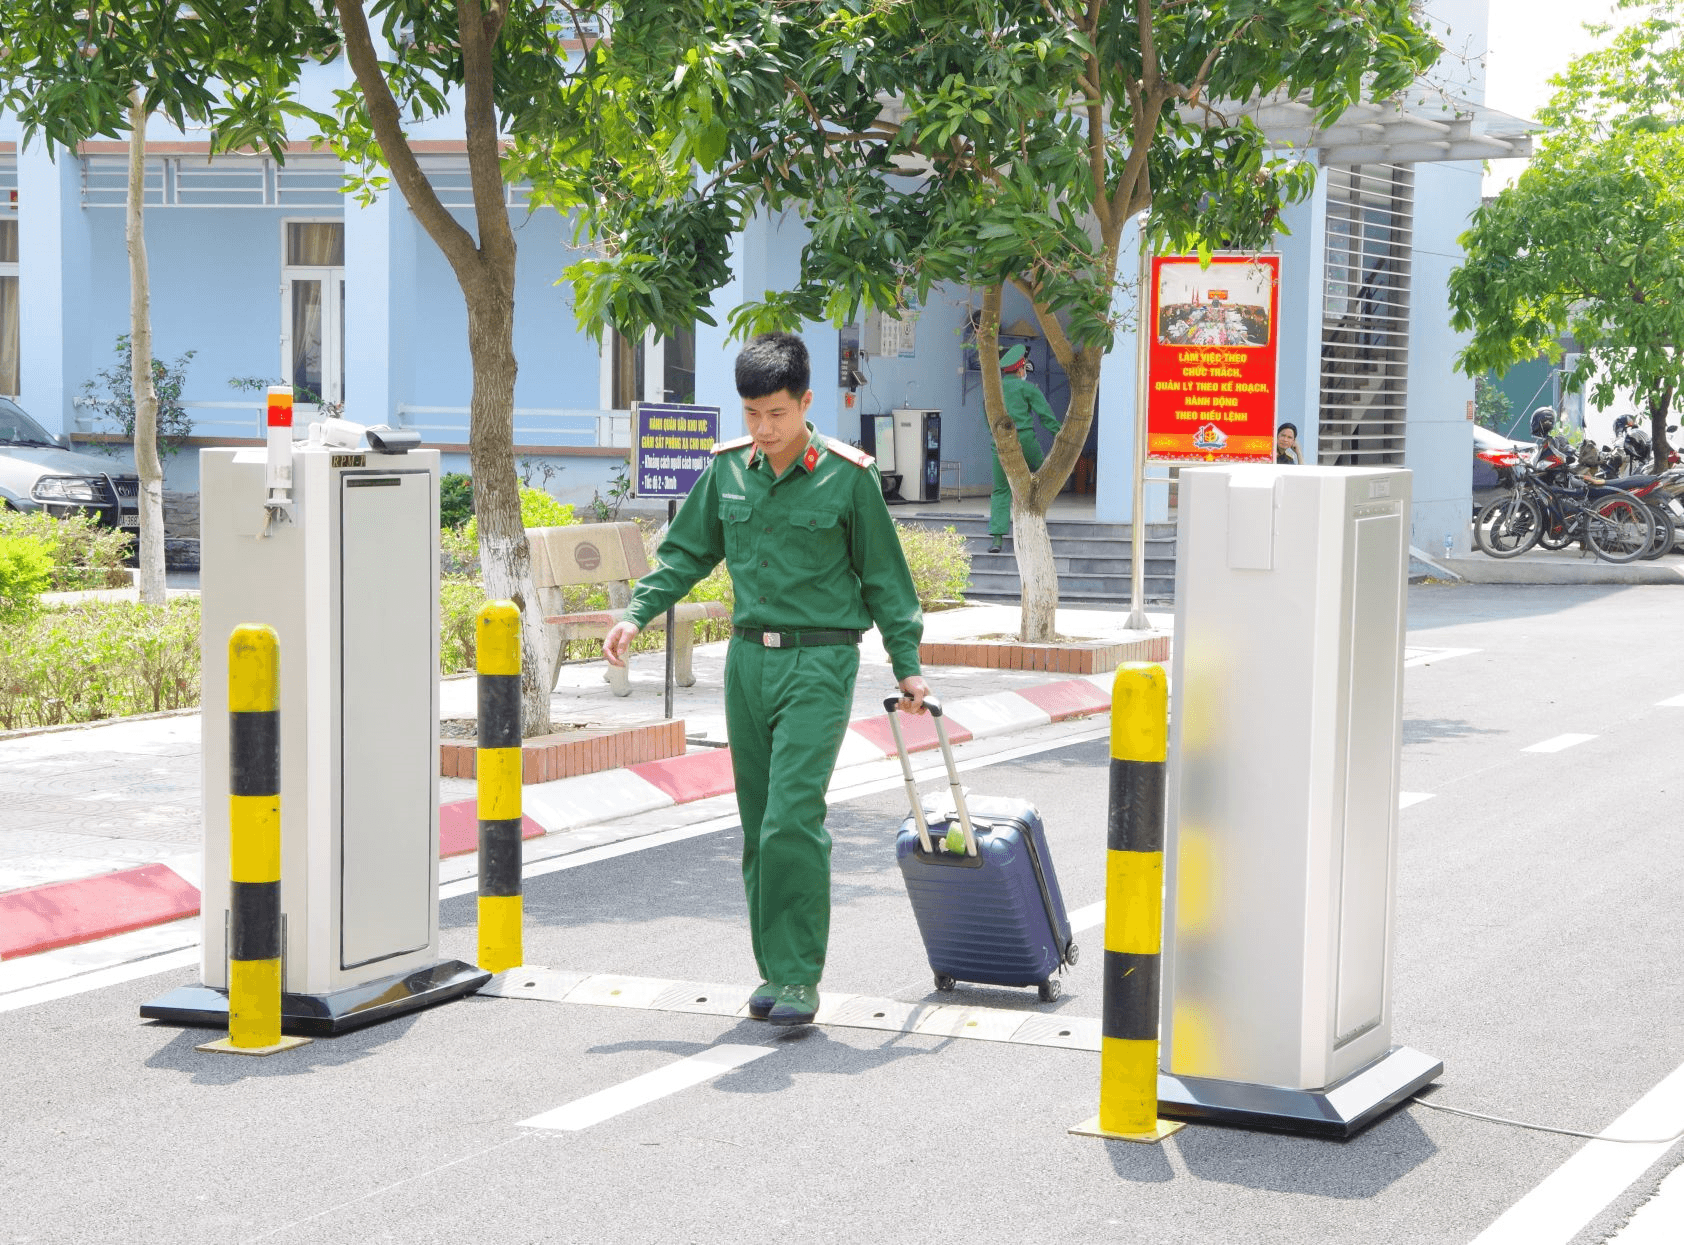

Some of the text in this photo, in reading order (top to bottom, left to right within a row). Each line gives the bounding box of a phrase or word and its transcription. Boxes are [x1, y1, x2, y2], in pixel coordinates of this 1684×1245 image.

[1178, 351, 1247, 363] LÀM VIỆC THEO
[1183, 366, 1207, 376] CHỨC
[1155, 379, 1180, 391] QUẢN
[1196, 382, 1218, 392] THEO
[1184, 395, 1210, 406] HÀNH
[1175, 410, 1198, 420] THEO
[1224, 411, 1248, 422] LỆNH
